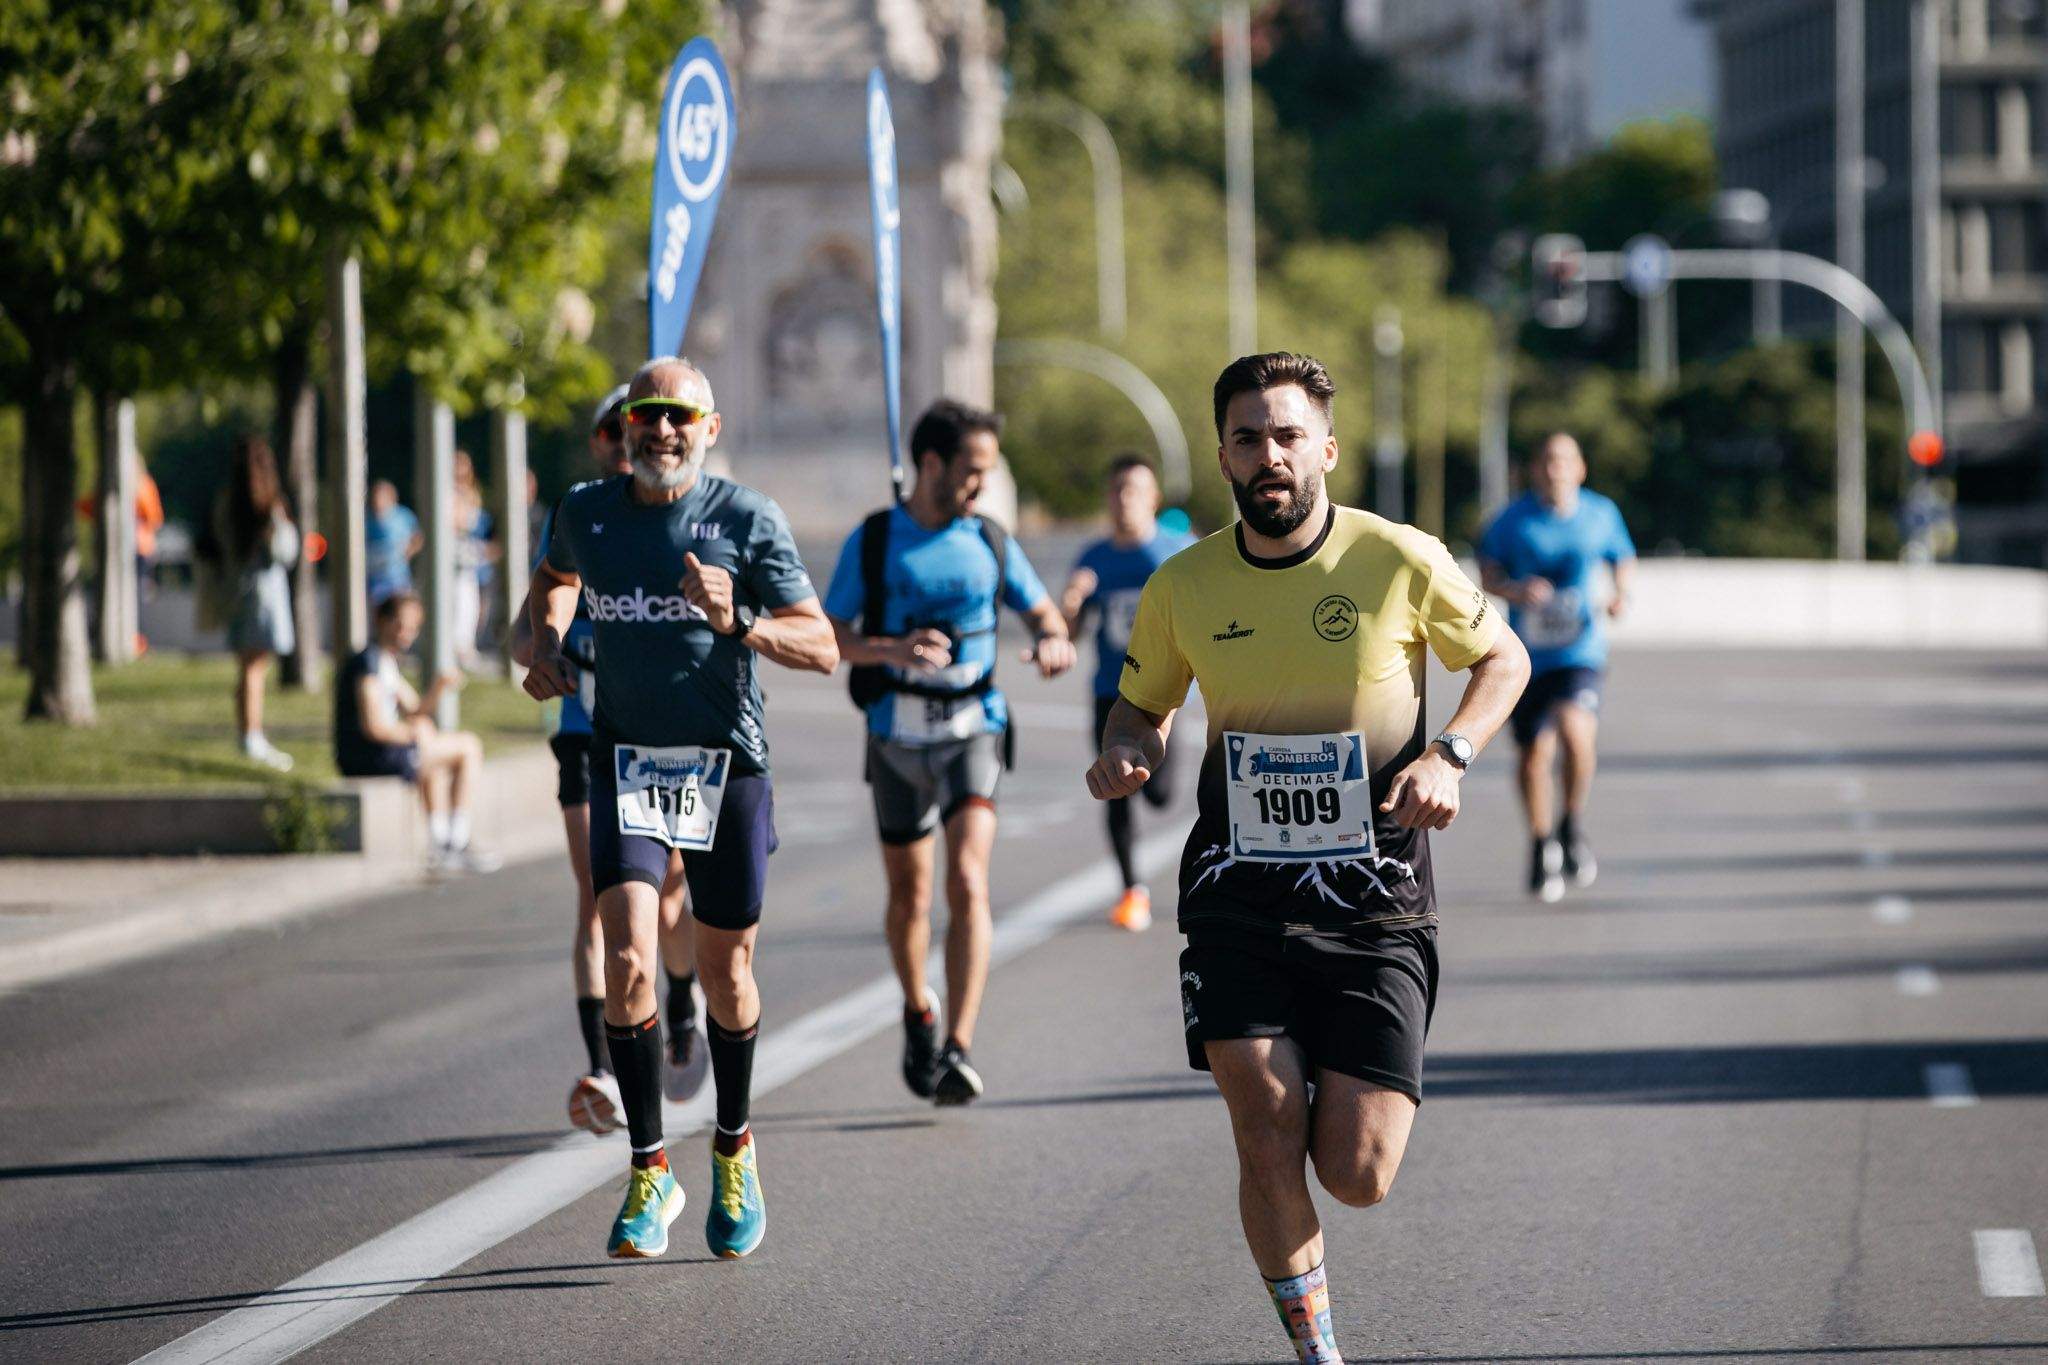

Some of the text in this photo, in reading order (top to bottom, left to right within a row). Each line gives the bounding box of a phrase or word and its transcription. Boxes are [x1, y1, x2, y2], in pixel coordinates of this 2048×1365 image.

[584, 585, 708, 622] Steelcas
[1213, 628, 1255, 641] TEAMERGY
[1269, 752, 1335, 764] BOMBEROS
[1263, 773, 1336, 785] DECIMAS
[642, 784, 696, 816] 1515
[1252, 787, 1341, 826] 1909
